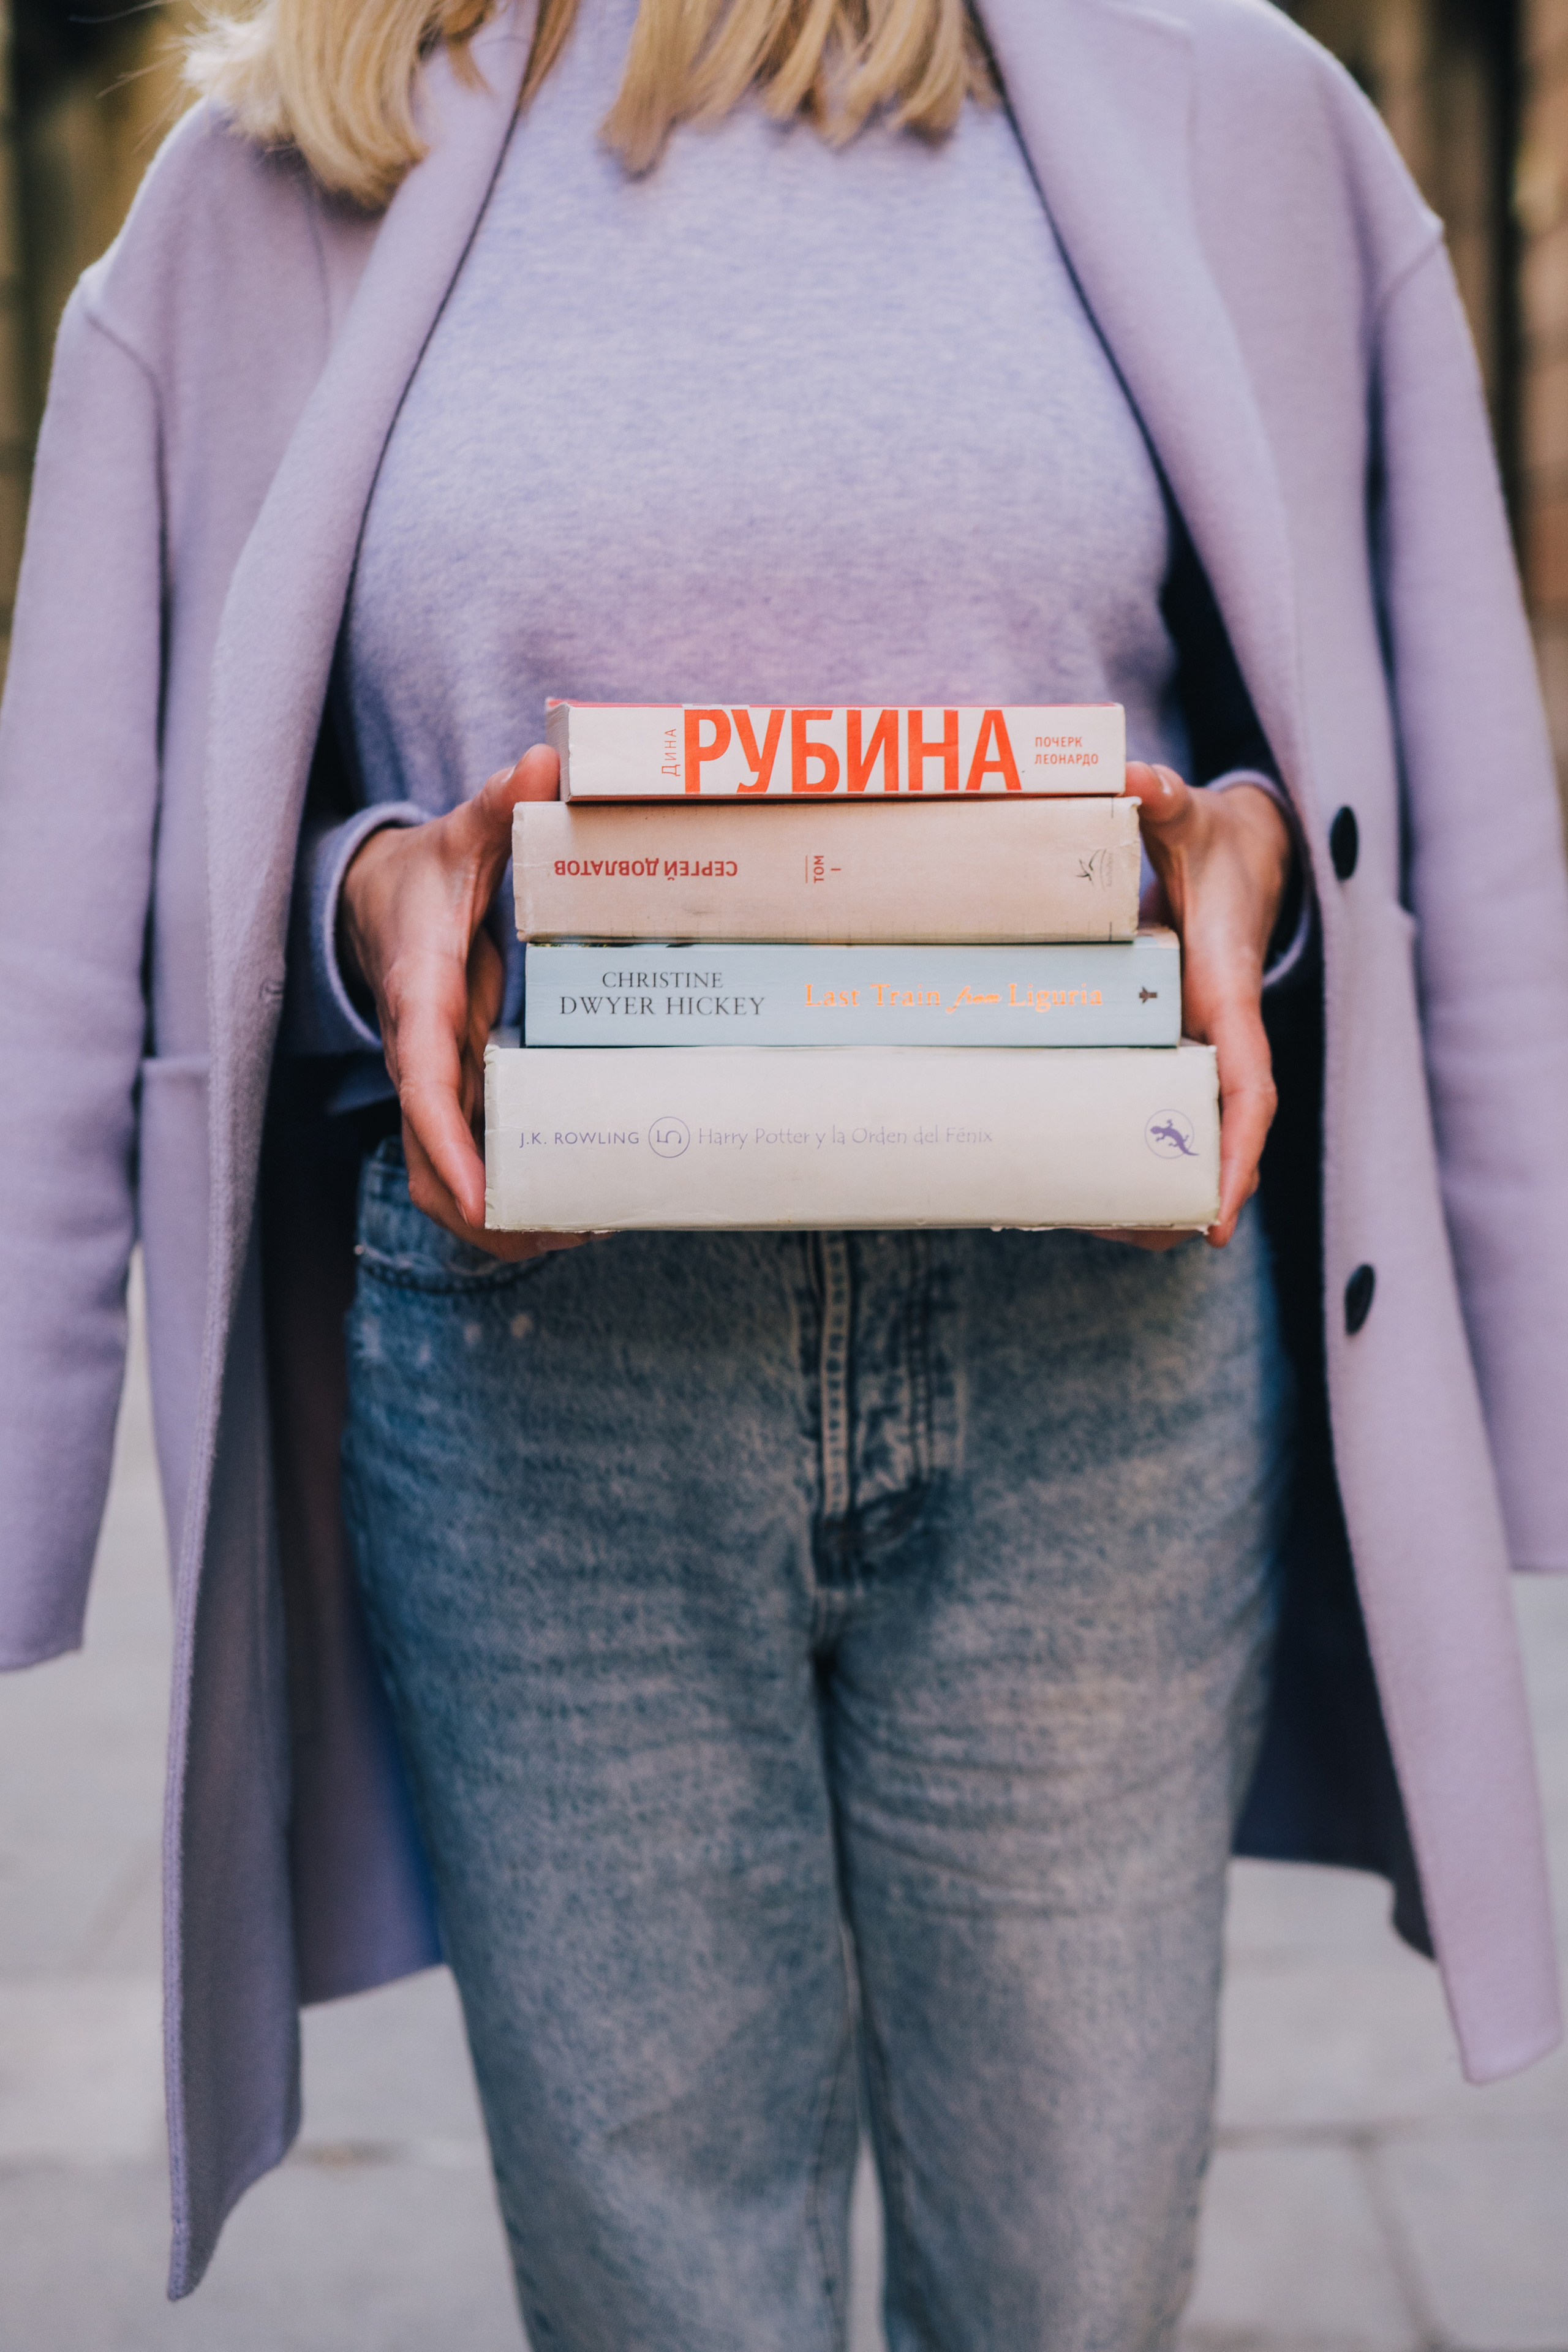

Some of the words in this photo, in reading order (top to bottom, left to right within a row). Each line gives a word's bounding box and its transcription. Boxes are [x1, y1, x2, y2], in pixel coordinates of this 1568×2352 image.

[684, 709, 1022, 794] РУБИНА
[1035, 736, 1083, 748] ПОЧЕРК
[661, 728, 681, 777] ДИНА
[1034, 753, 1099, 766] ЛЕОНАРДО
[554, 858, 660, 876] ДОВЛАТОВ
[663, 860, 739, 881] СЕРГЕЙ
[813, 854, 824, 884] ТОМ
[601, 971, 723, 989] CHRISTINE
[560, 996, 656, 1015] DWYER
[665, 996, 766, 1015] HICKEY
[804, 983, 860, 1007] Last
[870, 983, 941, 1007] Train
[945, 985, 1001, 1014] from
[1008, 982, 1103, 1013] Liguria
[519, 1132, 547, 1148] J.K.
[554, 1131, 639, 1145] ROWLING
[656, 1129, 682, 1144] 5
[698, 1128, 748, 1150] Harry
[755, 1128, 810, 1145] Potter
[815, 1133, 826, 1149] y
[832, 1125, 845, 1145] la
[852, 1126, 907, 1145] Orden
[913, 1126, 939, 1145] del
[946, 1126, 993, 1144] Fénix
